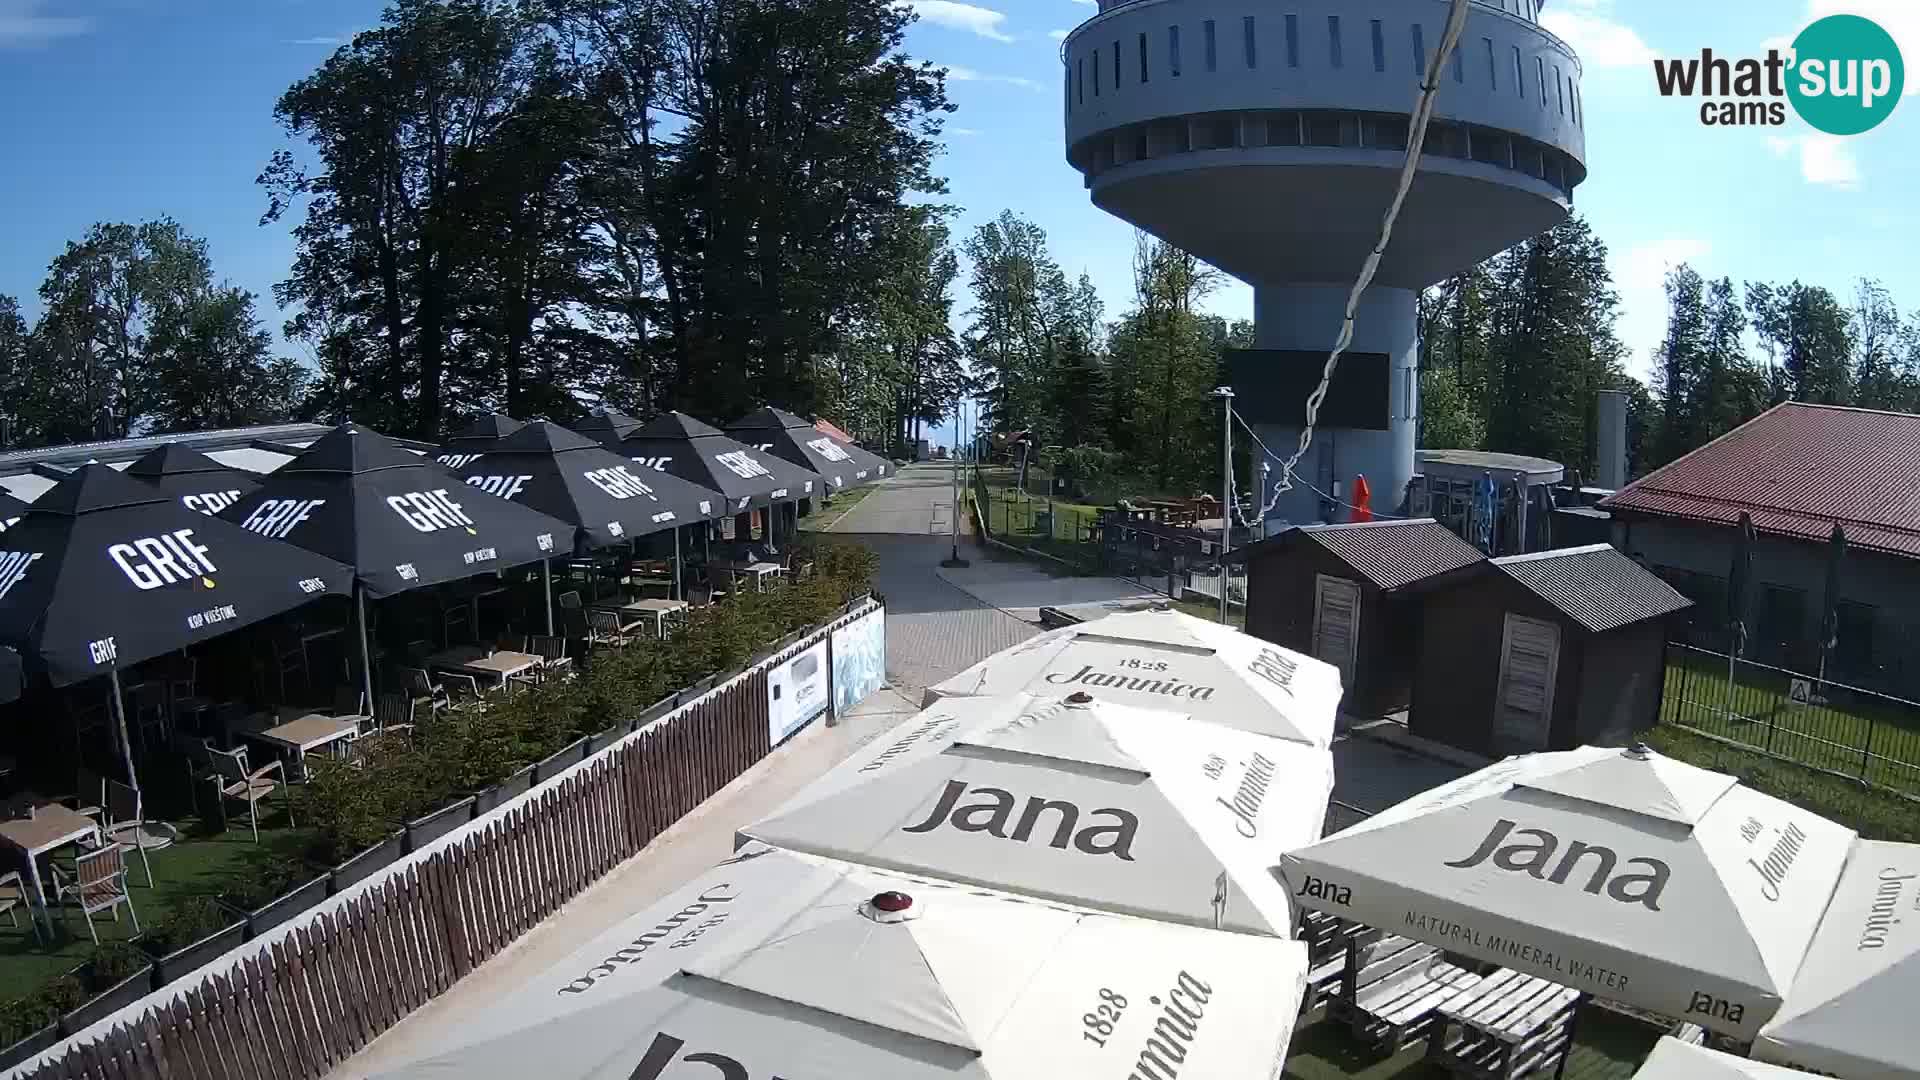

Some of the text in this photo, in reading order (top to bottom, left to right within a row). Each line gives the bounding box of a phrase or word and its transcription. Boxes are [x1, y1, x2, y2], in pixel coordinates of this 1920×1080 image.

[241, 500, 326, 538] GRIF
[387, 488, 474, 532] GRIF
[0, 551, 44, 599] RIF
[108, 529, 217, 590] GRIF
[299, 577, 326, 593] GRIF
[89, 637, 117, 664] GRIF
[1046, 665, 1215, 700] Jamnica
[1216, 752, 1275, 838] Jamnica
[1747, 822, 1806, 902] Jamnica
[1405, 911, 1629, 992] NATURAL MINERAL WATER
[1083, 988, 1128, 1048] 1828
[1128, 970, 1212, 1080] mnica
